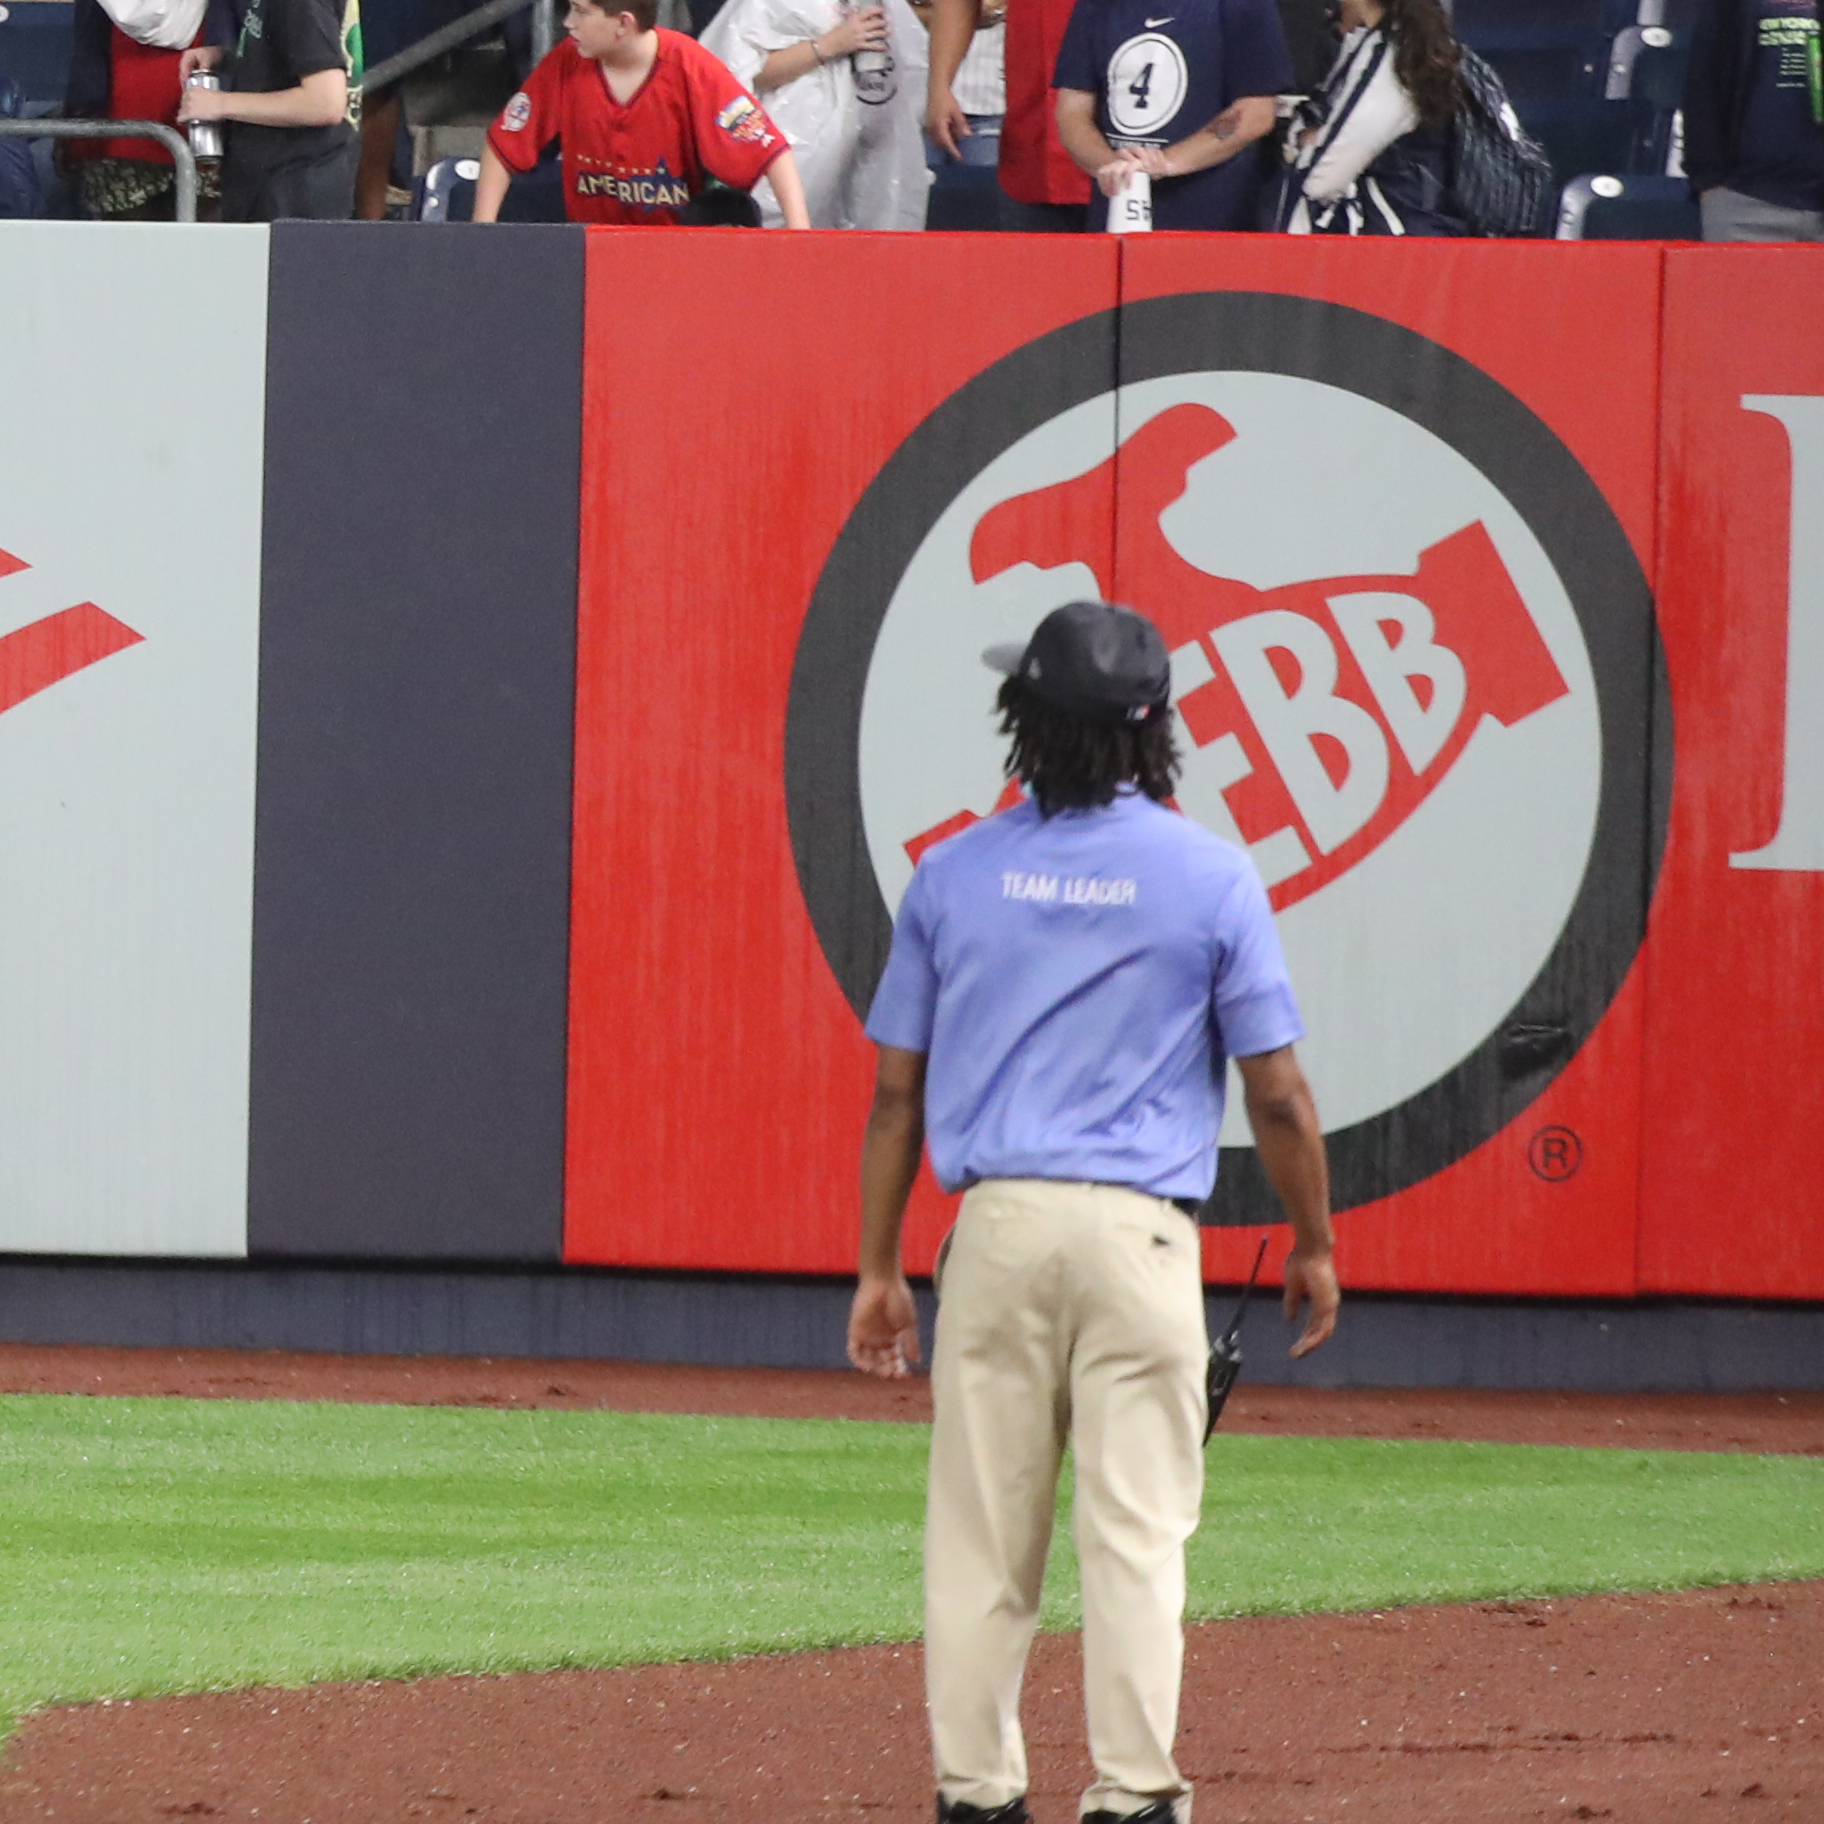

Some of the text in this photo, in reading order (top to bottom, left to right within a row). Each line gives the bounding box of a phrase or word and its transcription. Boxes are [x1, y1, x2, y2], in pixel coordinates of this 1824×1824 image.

[1129, 63, 1155, 110] 4
[577, 175, 691, 207] AMERICAN
[1001, 871, 1138, 908] TEAM LEADER
